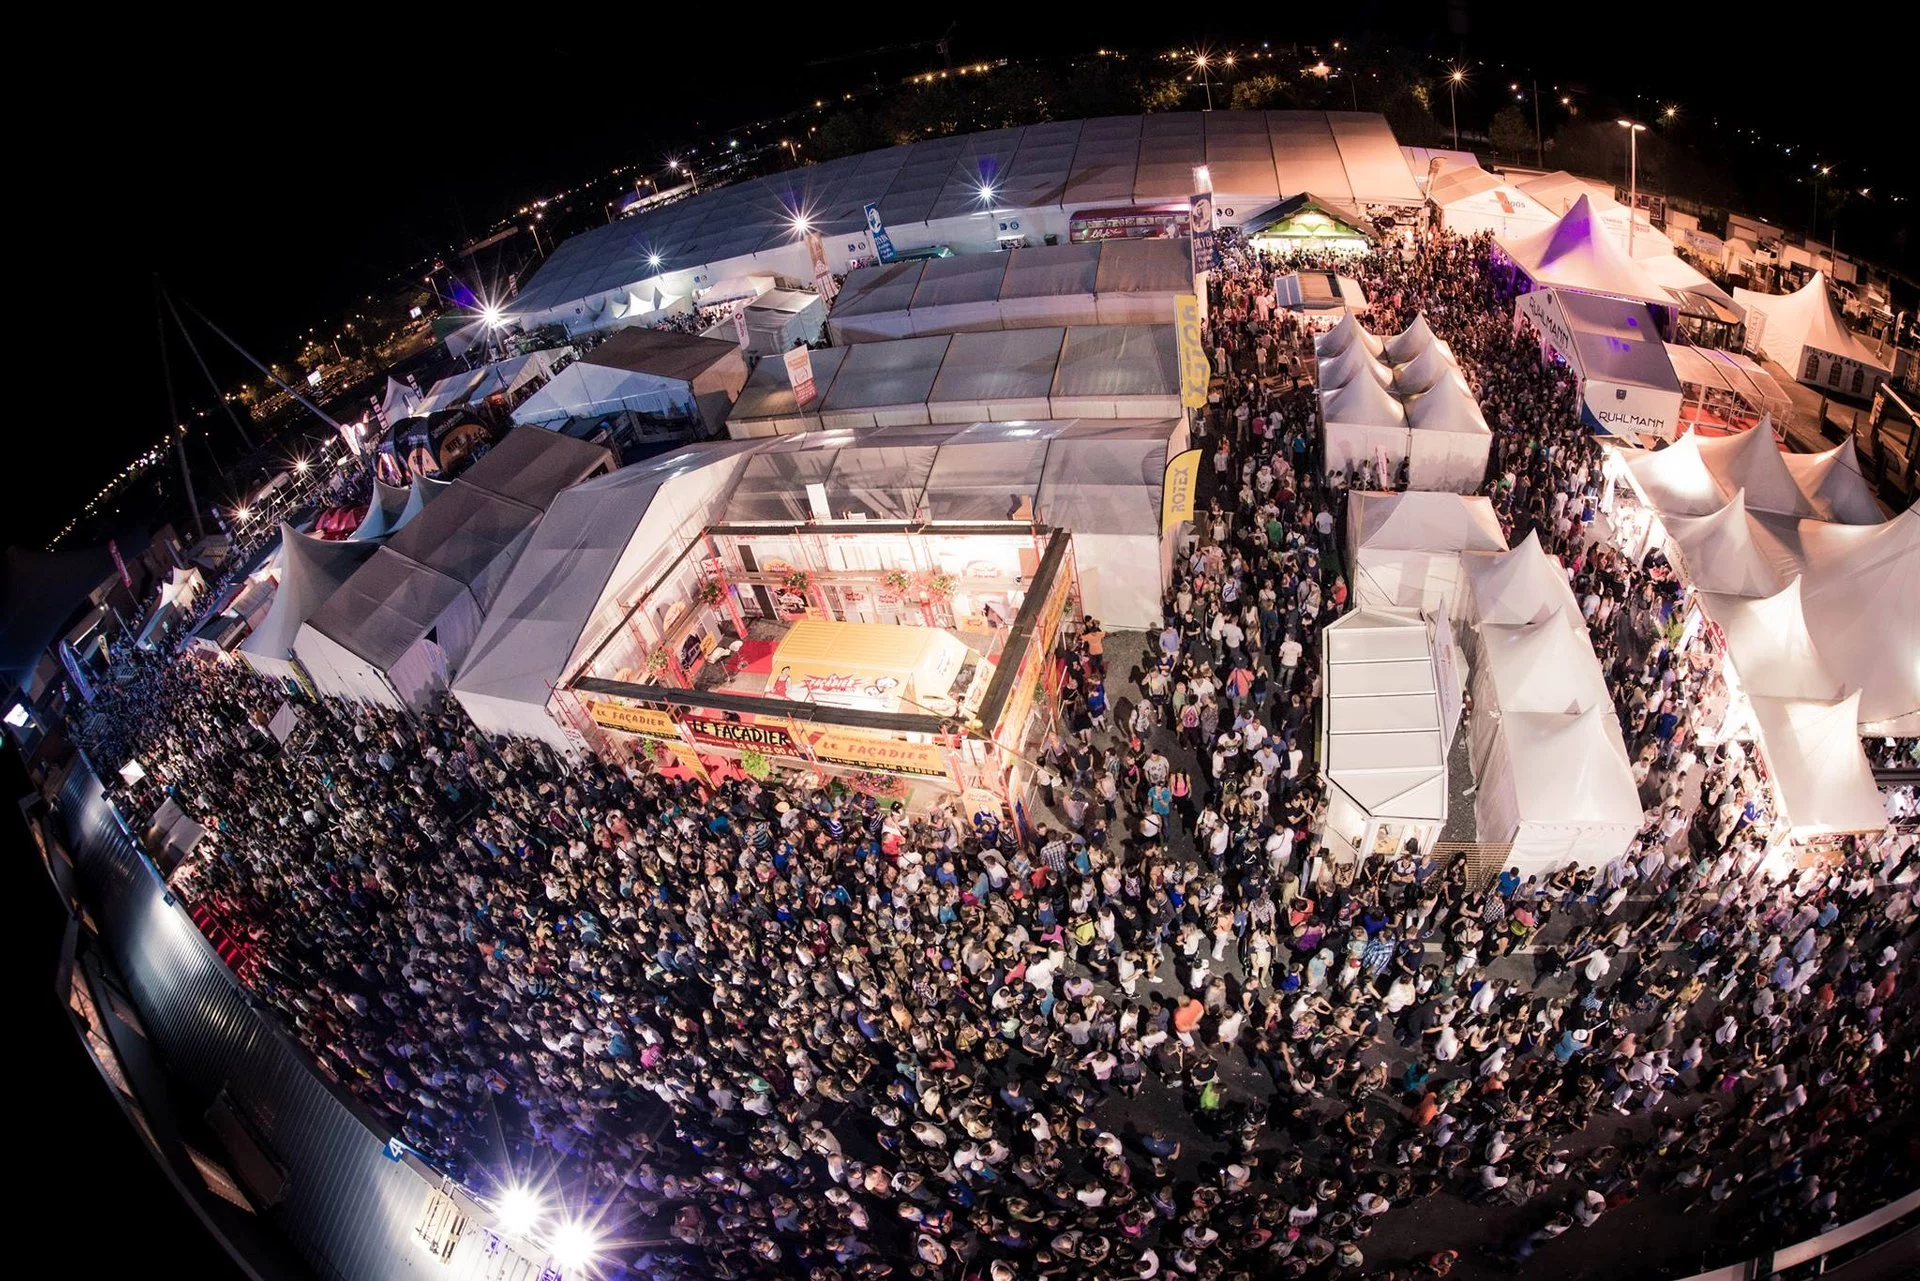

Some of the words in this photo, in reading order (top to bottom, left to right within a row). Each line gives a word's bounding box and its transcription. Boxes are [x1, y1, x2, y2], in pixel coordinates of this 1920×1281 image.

[1528, 295, 1569, 348] RUHLMANN
[1598, 411, 1664, 429] RUHLMANN
[1171, 467, 1189, 513] ROTEX
[612, 712, 665, 727] FAÇADIER
[692, 720, 709, 735] LE
[760, 746, 774, 754] 22
[773, 747, 786, 755] 00
[787, 748, 800, 757] 41
[823, 741, 839, 751] LE
[848, 744, 929, 761] FAÇADIER
